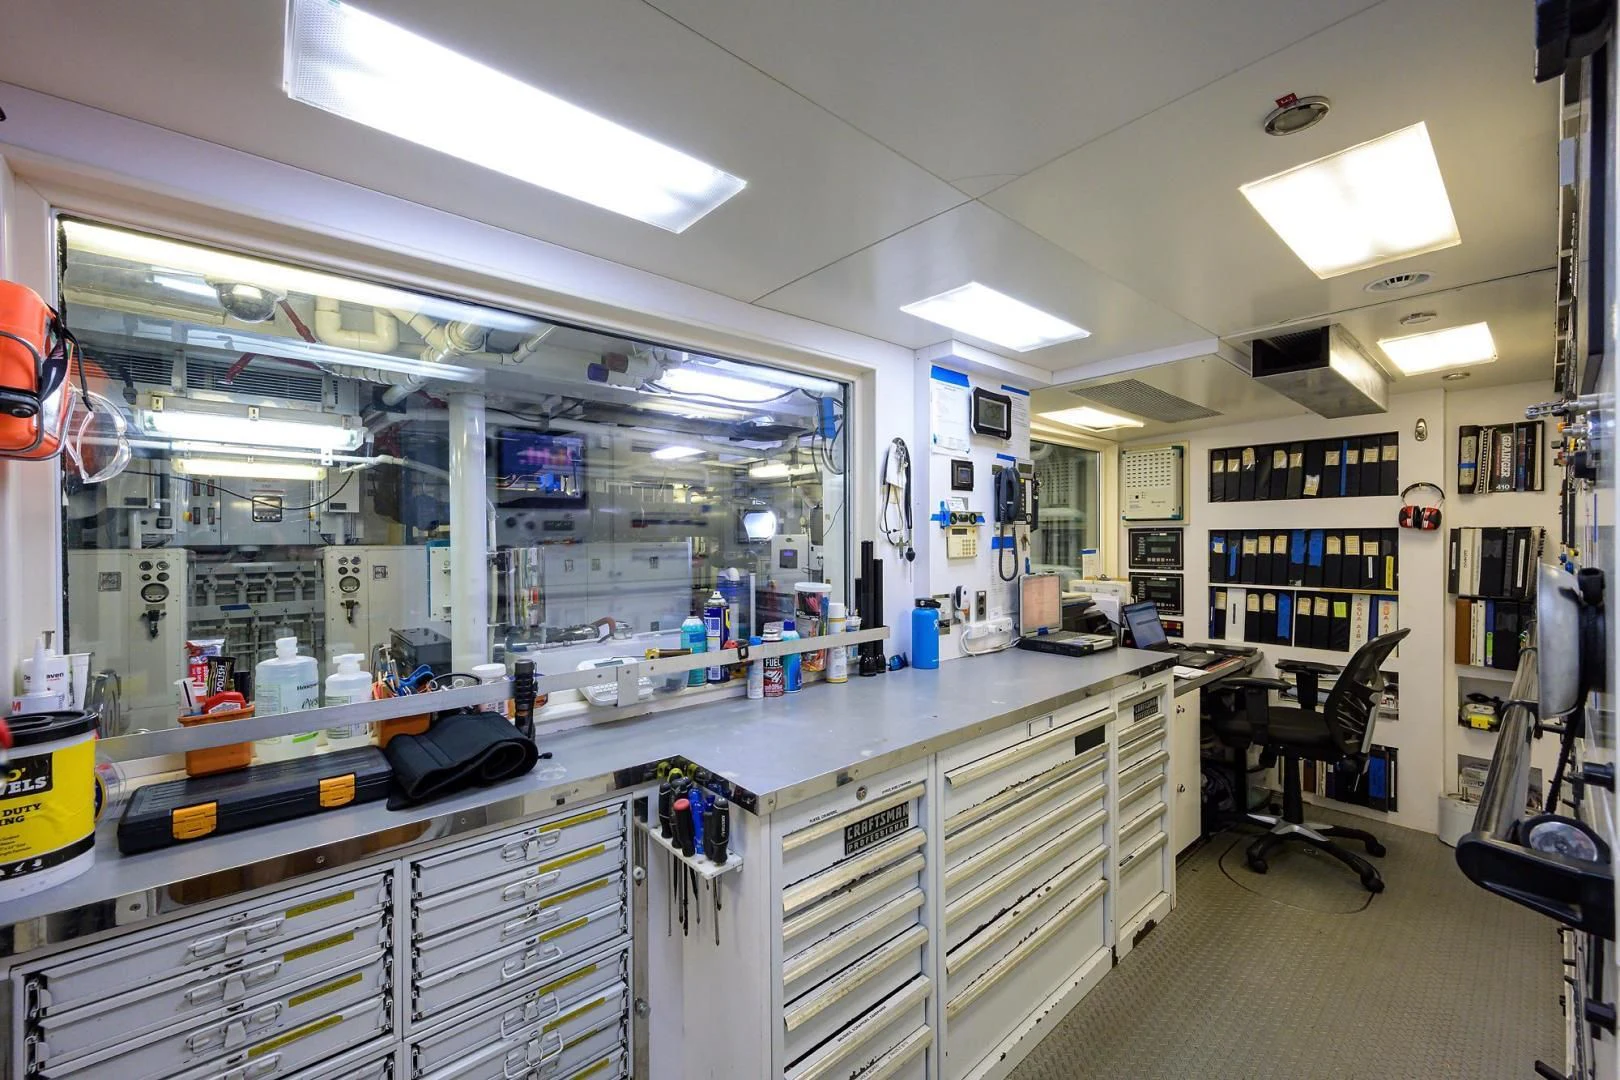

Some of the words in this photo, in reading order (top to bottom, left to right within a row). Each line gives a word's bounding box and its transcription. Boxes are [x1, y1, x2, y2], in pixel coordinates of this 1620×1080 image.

[1501, 434, 1512, 478] GRAINGER
[765, 657, 781, 667] FUEL
[216, 664, 226, 692] POLISH
[0, 815, 25, 827] ING
[3, 802, 42, 817] DUTY
[847, 804, 909, 840] CRAFTSMAN
[847, 820, 909, 853] PROFESSIONAL
